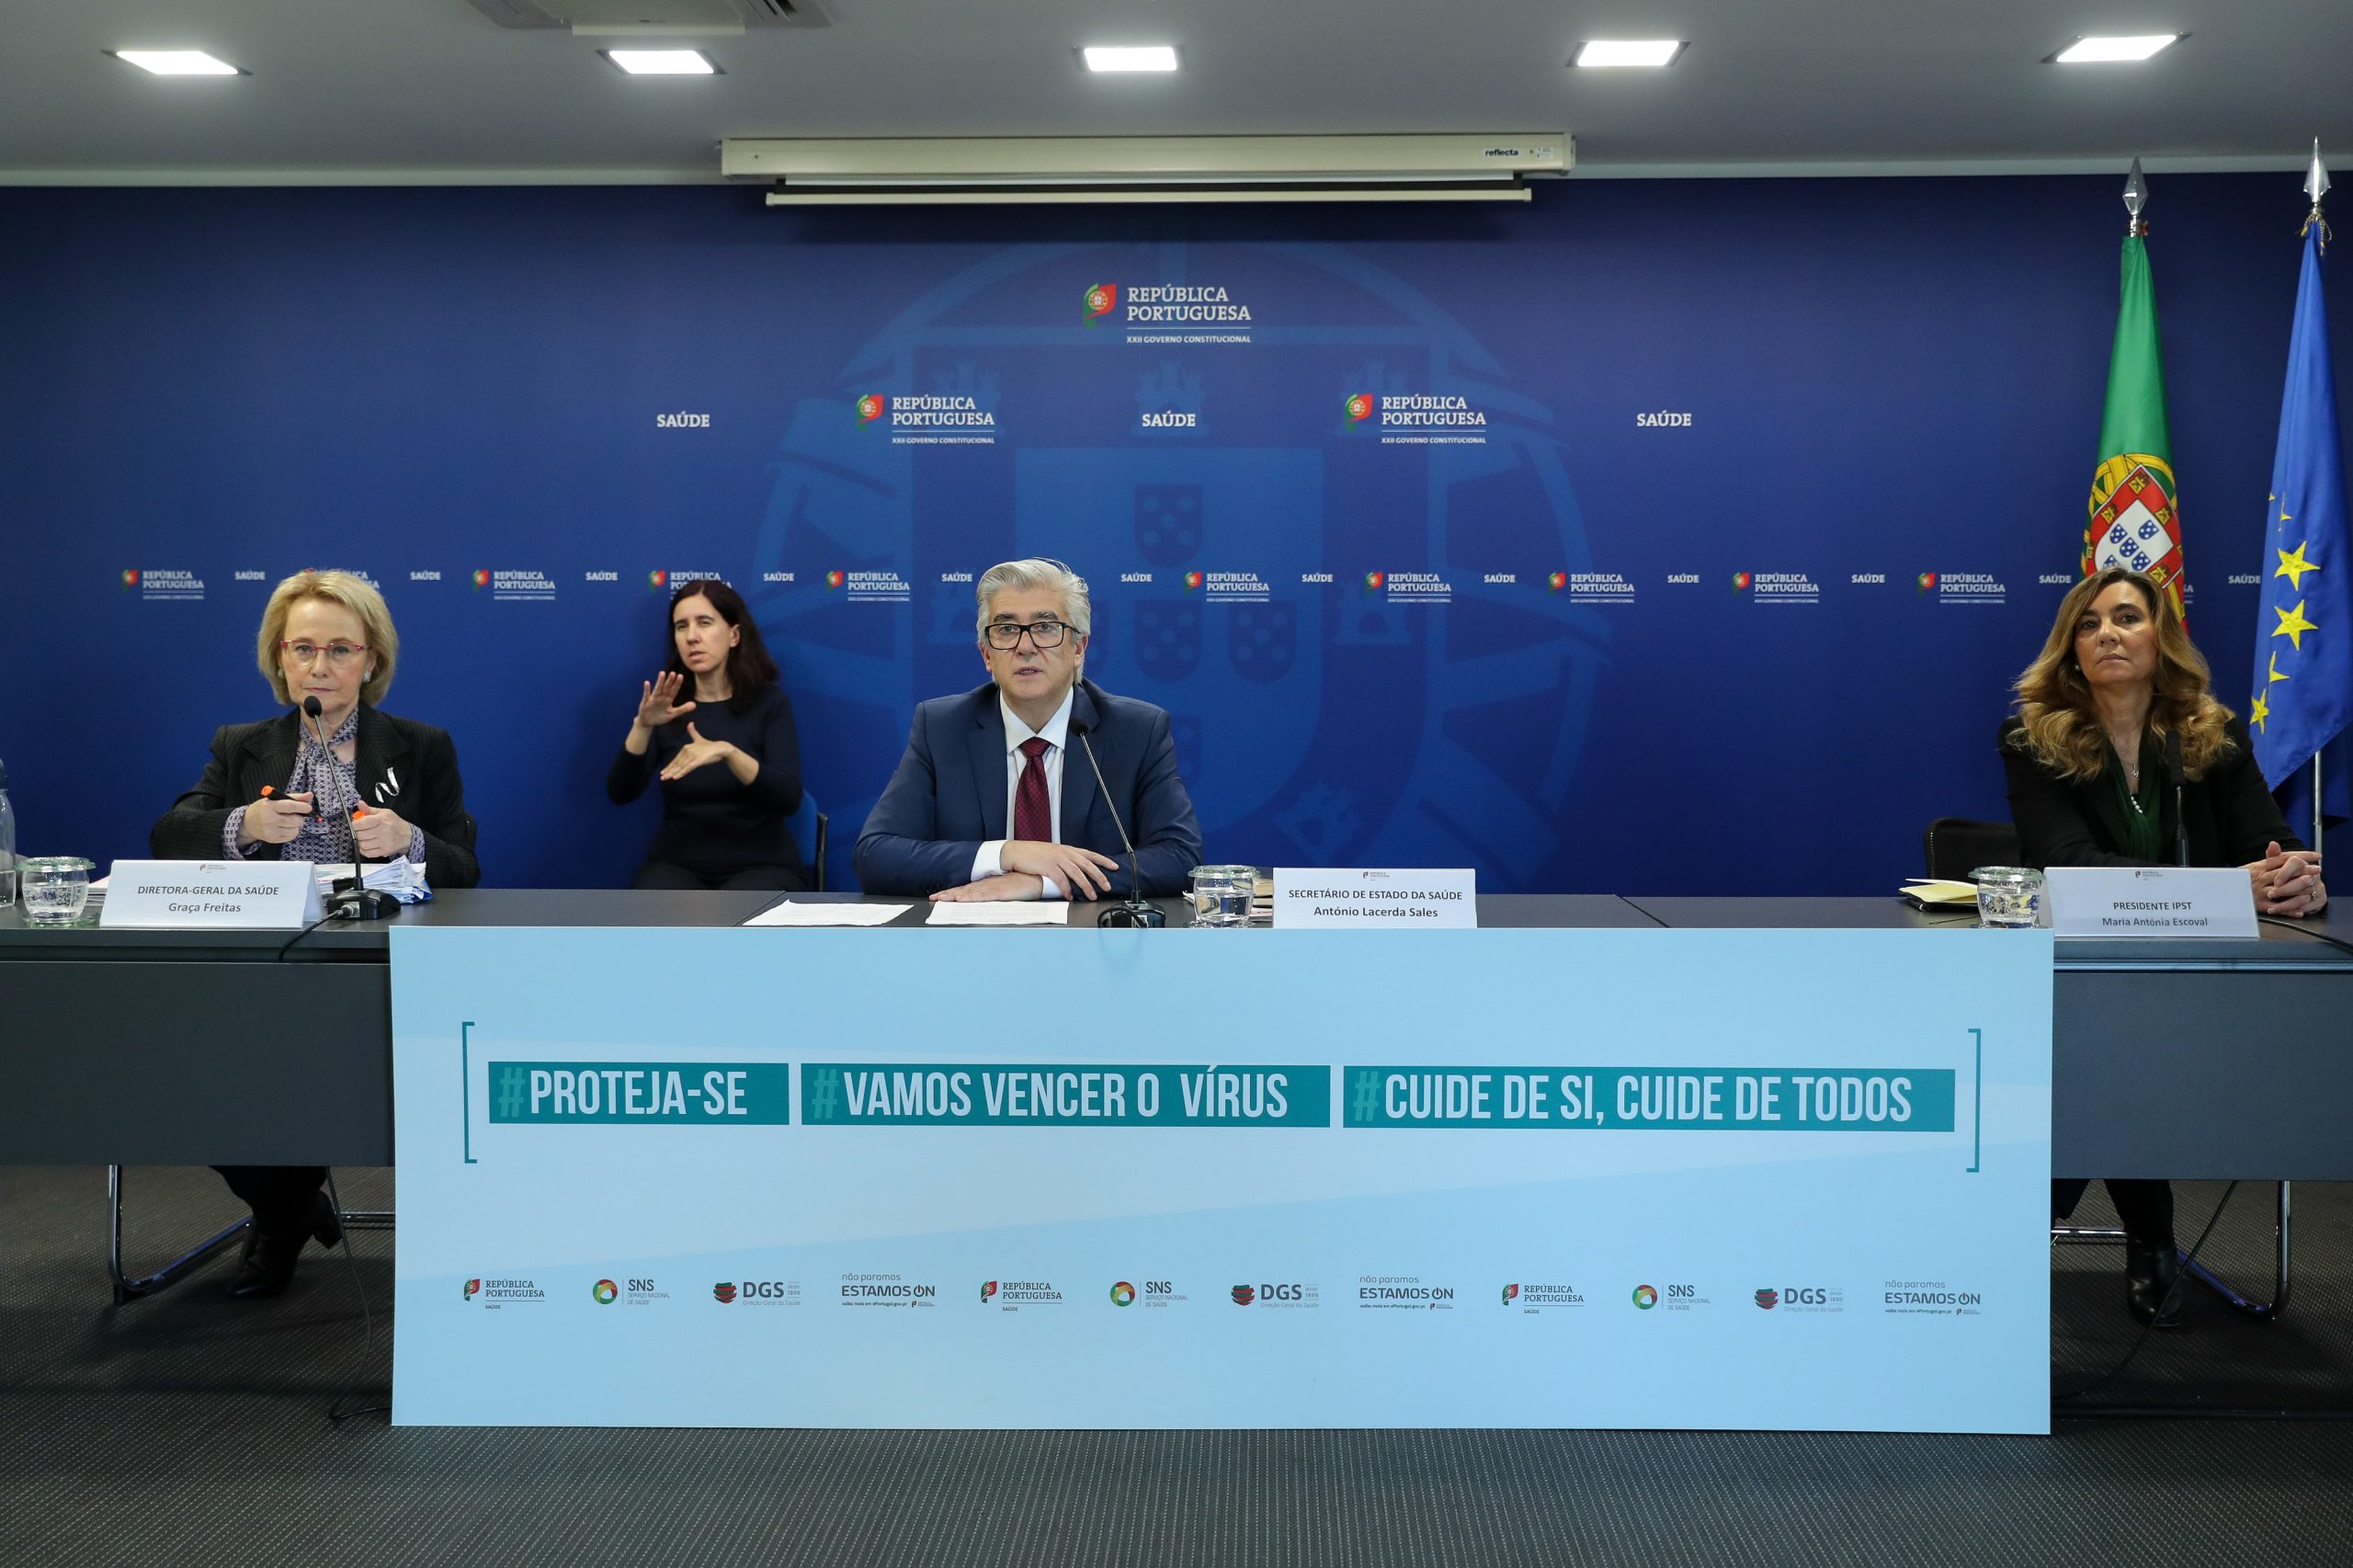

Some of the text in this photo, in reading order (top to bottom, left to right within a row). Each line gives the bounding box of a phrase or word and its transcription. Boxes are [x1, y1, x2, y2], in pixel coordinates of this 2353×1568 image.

[1485, 148, 1518, 156] reflecta
[1127, 284, 1229, 302] REPÚBLICA
[1127, 305, 1251, 322] PORTUGUESA
[1143, 335, 1182, 344] GOVERNO
[1184, 335, 1251, 344] CONSTITUCIONAL
[892, 395, 976, 411] REPÚBLICA
[1381, 394, 1468, 410] REPÚBLICA
[656, 412, 710, 428] SAÚDE
[892, 413, 995, 426] PORTUGUESA
[1142, 412, 1196, 428] SAÚDE
[1381, 412, 1486, 426] PORTUGUESA
[1636, 411, 1692, 427] SAÚDE
[142, 570, 193, 581] REPÚBLICA
[234, 570, 266, 580] SAÚDE
[410, 570, 441, 580] SAÚDE
[494, 570, 544, 581] REPÚBLICA
[585, 571, 618, 581] SAÚDE
[764, 572, 794, 582] SAÚDE
[847, 571, 899, 582] REPÚBLICA
[941, 573, 972, 583] SAÚDE
[1120, 573, 1152, 583] SAÚDE
[1206, 572, 1258, 583] REPÚBLICA
[1302, 573, 1333, 583] SAÚDE
[1388, 573, 1440, 584] REPÚBLICA
[1483, 574, 1516, 584] SAÚDE
[1571, 573, 1623, 584] REPÚBLICA
[1667, 574, 1699, 584] SAÚDE
[1755, 573, 1808, 584] REPÚBLICA
[1851, 573, 1885, 584] SAÚDE
[1940, 573, 1994, 584] REPÚBLICA
[2039, 573, 2072, 584] SAÚDE
[2228, 574, 2261, 584] SAÚDE
[142, 580, 204, 590] PORTUGUESA
[494, 581, 555, 590] PORTUGUESA
[847, 582, 910, 591] PORTUGUESA
[1206, 583, 1269, 592] PORTUGUESA
[1388, 583, 1451, 593] PORTUGUESA
[1571, 584, 1634, 593] PORTUGUESA
[1755, 584, 1819, 593] PORTUGUESA
[1940, 583, 2006, 593] PORTUGUESA
[137, 884, 279, 896] DIRETORA-GERAL DA SAÚDE
[1289, 888, 1462, 900] SECRETÁRIO DE ESTADO DA SAÚDE
[168, 903, 242, 914] Graça Freitas
[1313, 906, 1438, 917] António Lacerda Sales
[2113, 902, 2192, 911] PRESIDENTE IPST
[2102, 917, 2208, 926] Maria Antónia Escoval
[498, 1067, 748, 1117] #PROTEJA-SE
[812, 1064, 1288, 1119] #VAMOS VENCER O VÍRUS
[1353, 1071, 1912, 1125] #CUIDE DE SI, CUIDE DE TODOS
[485, 1279, 534, 1289] REPÚBLICA
[860, 1274, 901, 1283] paramos
[1360, 1275, 1419, 1286] não paramos
[628, 1279, 654, 1291] SNS
[743, 1282, 785, 1299] DGS
[1003, 1281, 1051, 1290] REPÚBLICA
[1145, 1281, 1172, 1294] SNS
[1524, 1284, 1573, 1293] REPÚBLICA
[1904, 1281, 1946, 1290] paramos
[485, 1290, 545, 1298] PORTUGUESA
[842, 1285, 911, 1297] ESTAMOS
[1003, 1291, 1063, 1300] PORTUGUESA
[1261, 1284, 1302, 1301] DGS
[1360, 1288, 1429, 1299] ESTAMOS
[1668, 1285, 1695, 1298] SNS
[1785, 1288, 1826, 1304] DGS
[1524, 1294, 1584, 1302] PORTUGUESA
[1885, 1292, 1956, 1304] ESTAMOS
